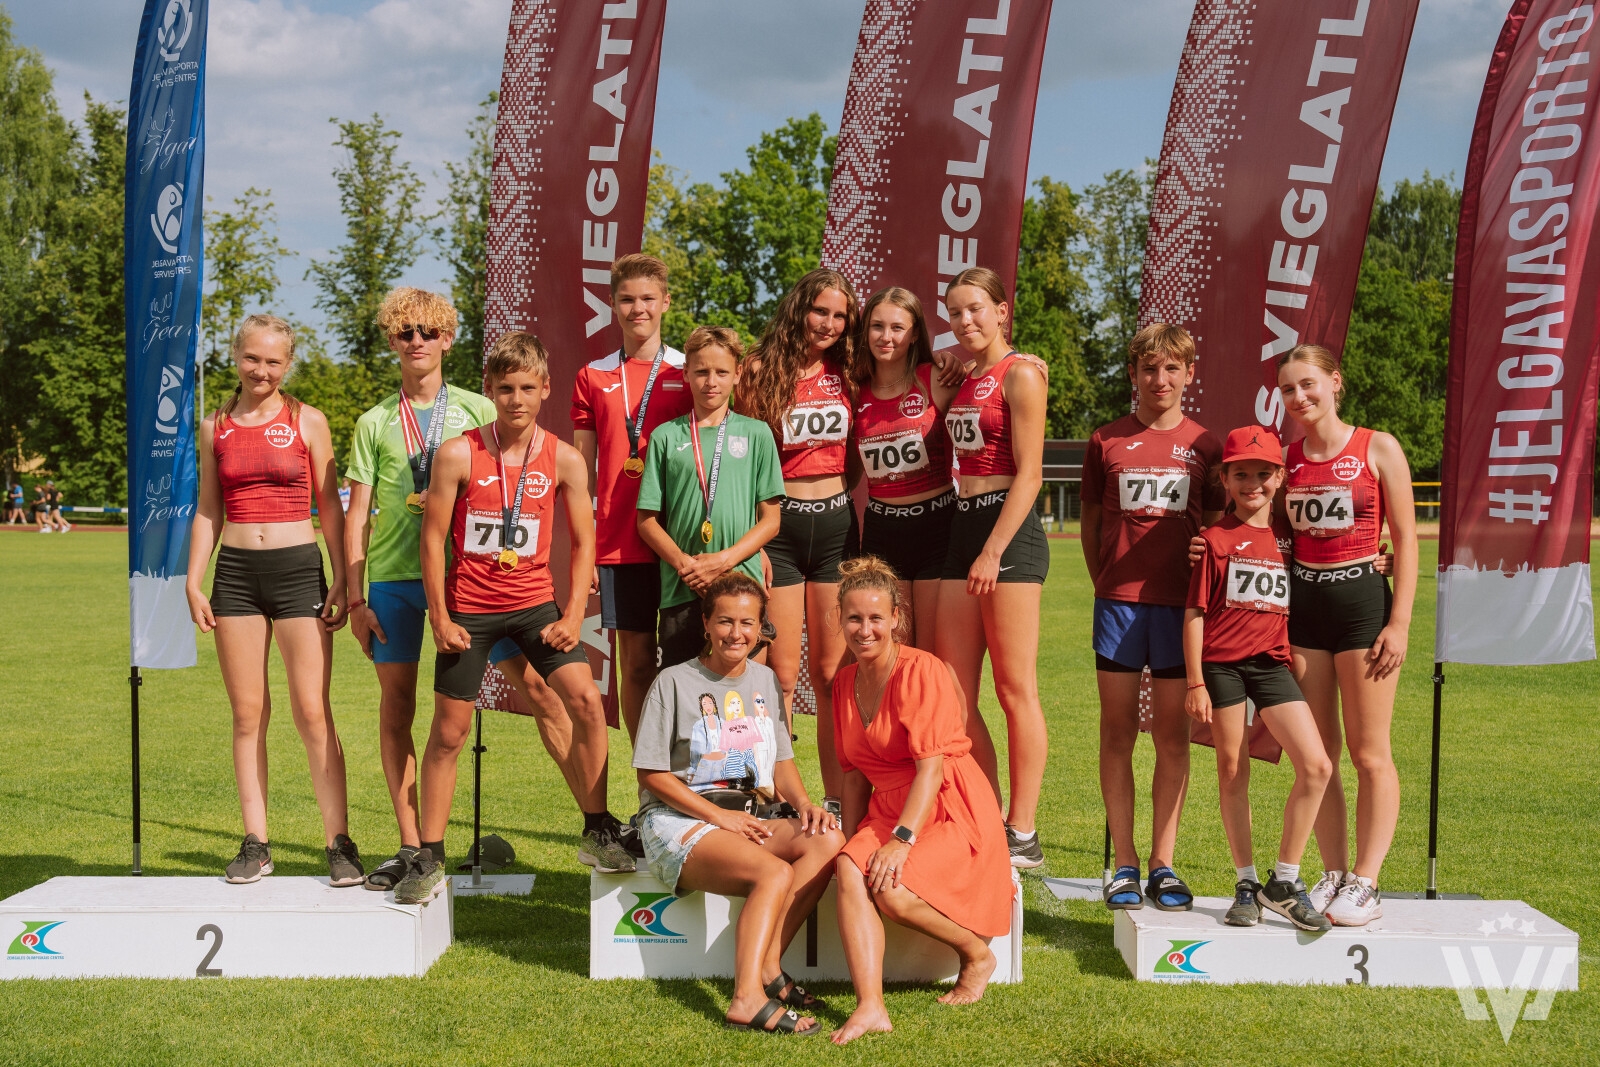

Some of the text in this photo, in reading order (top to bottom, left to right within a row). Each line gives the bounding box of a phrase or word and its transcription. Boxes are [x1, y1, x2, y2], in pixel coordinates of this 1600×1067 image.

[582, 0, 638, 338] VIEGLATL
[1261, 0, 1370, 361] VIEGLATL
[1488, 5, 1594, 525] #JELGAVASPORTO
[790, 411, 842, 436] 702
[864, 441, 921, 470] 706
[786, 500, 826, 513] PRO
[830, 491, 851, 510] NIK
[884, 505, 924, 517] PRO
[931, 492, 959, 511] NIK
[976, 493, 1009, 509] NIK
[1127, 479, 1180, 503] 714
[1290, 497, 1348, 522] 704
[474, 522, 529, 549] 710
[1235, 570, 1287, 599] 705
[1317, 566, 1362, 583] PRO
[196, 923, 224, 978] 2
[1345, 943, 1369, 986] 3
